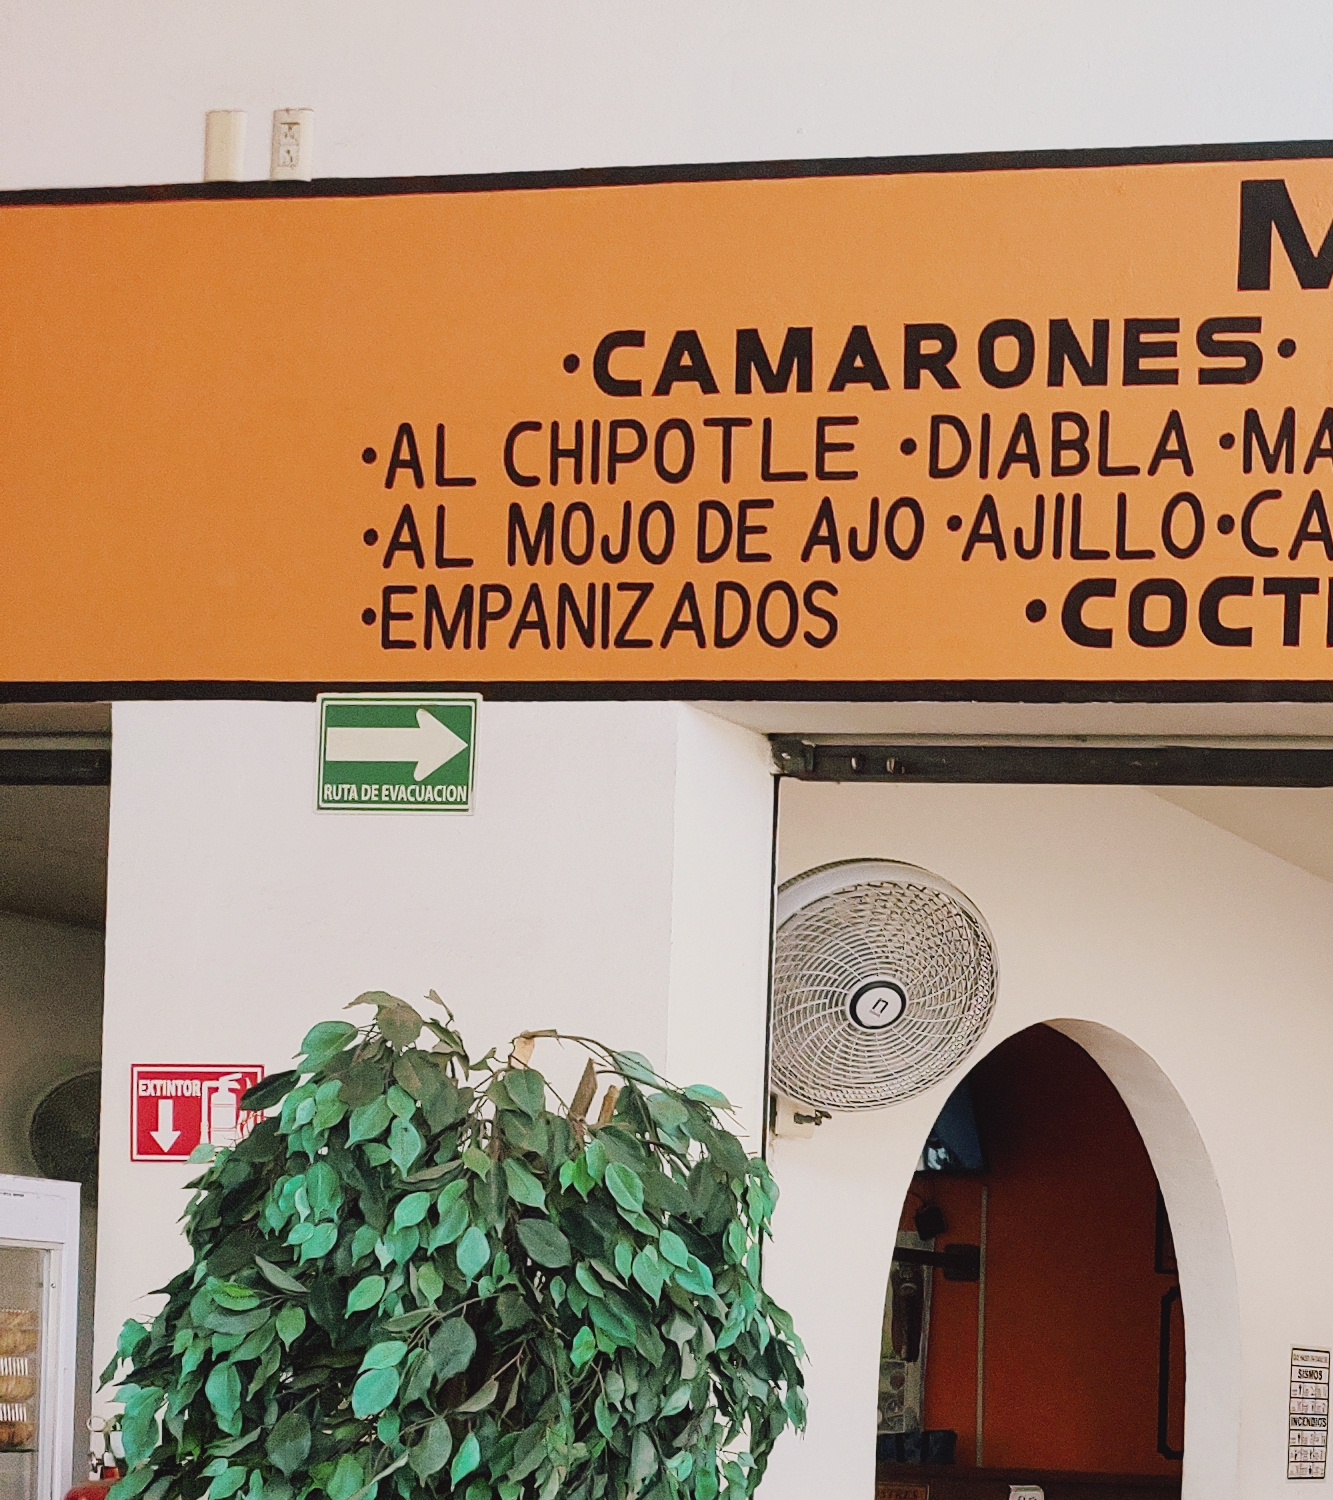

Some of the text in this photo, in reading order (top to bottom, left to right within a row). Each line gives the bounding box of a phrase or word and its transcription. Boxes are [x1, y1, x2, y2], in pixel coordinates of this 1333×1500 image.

[593, 317, 1263, 396] CAMARONES
[385, 423, 476, 489] AL
[504, 416, 858, 487] CHIPOTLE
[929, 410, 1193, 479] DIABLA
[383, 504, 473, 569] AL
[508, 501, 674, 566] MOJO
[698, 499, 774, 563] DE
[801, 497, 924, 563] AJO
[964, 492, 1204, 561] AJILLO
[382, 581, 838, 650] EMPANIZADOS
[324, 784, 467, 801] RUTA DE EVACUACION
[139, 1080, 202, 1097] EXTINTOR
[1297, 1369, 1322, 1380] SISMOS
[1290, 1417, 1327, 1428] INCENDIOS
